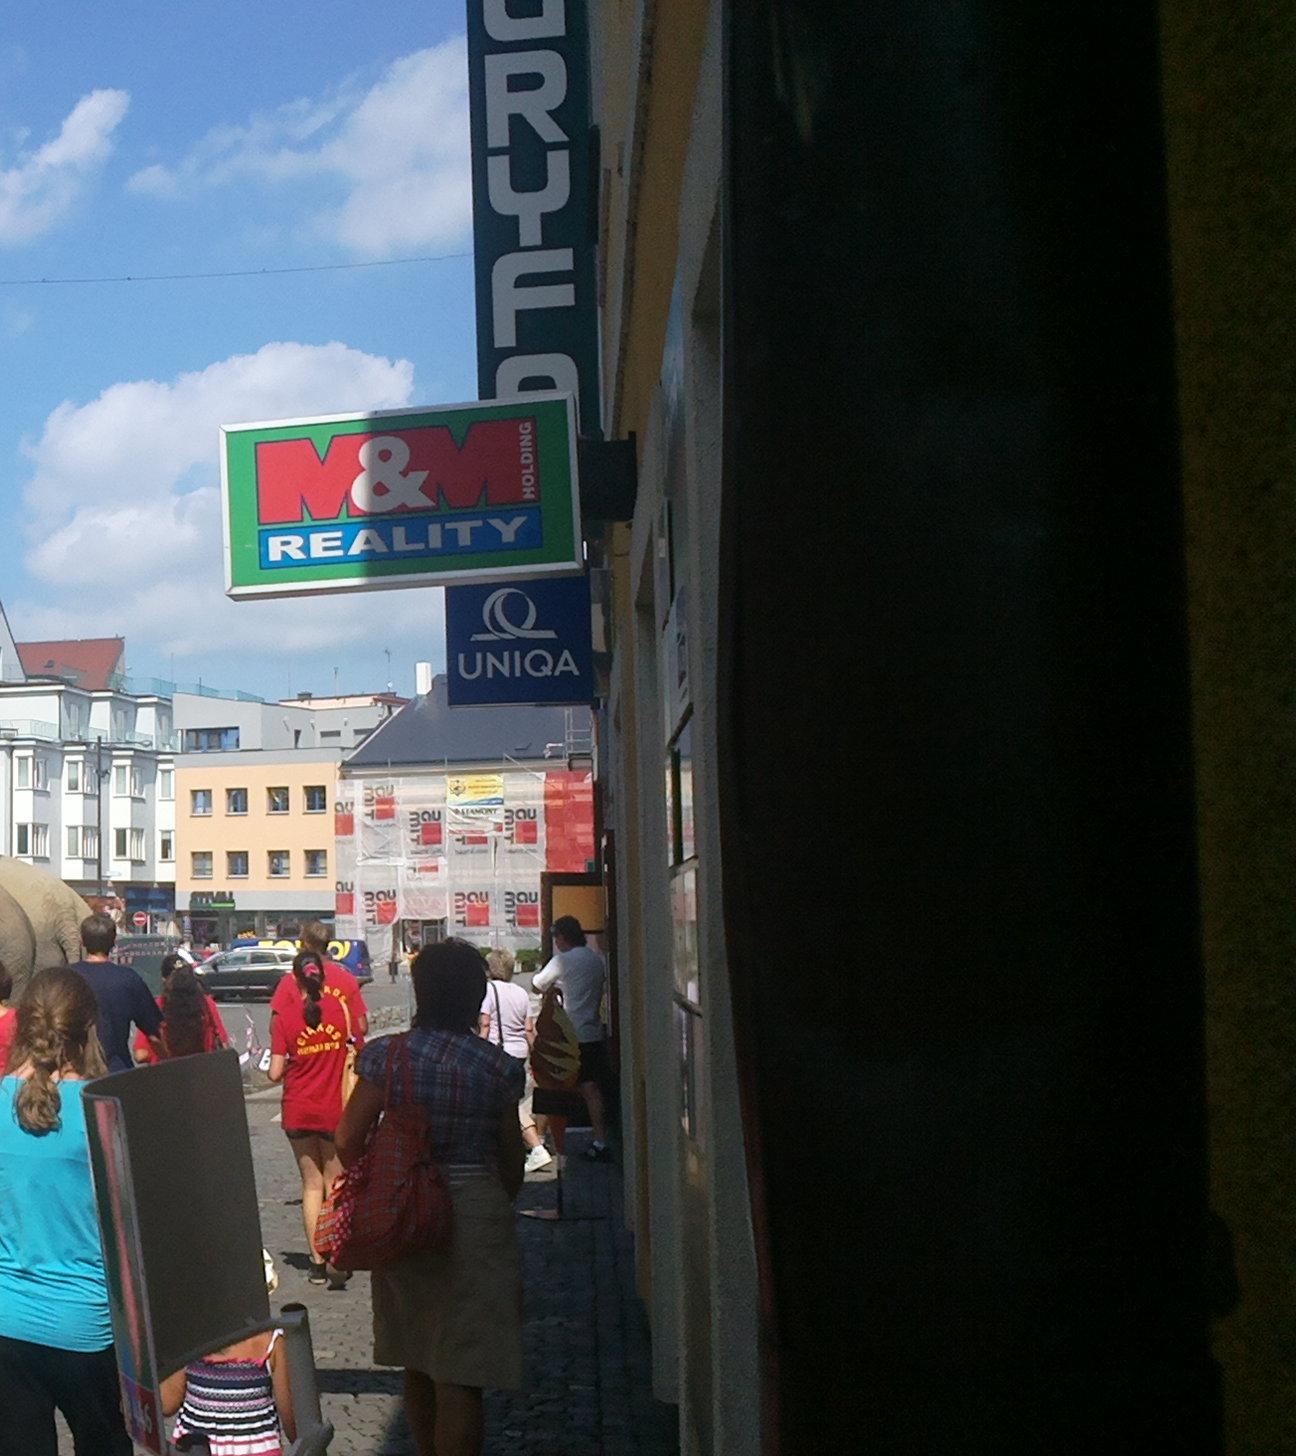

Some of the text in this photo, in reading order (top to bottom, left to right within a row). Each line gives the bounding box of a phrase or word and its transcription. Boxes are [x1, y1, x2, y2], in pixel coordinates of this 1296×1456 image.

[255, 417, 540, 525] M&M
[519, 421, 535, 499] HOLDING
[267, 516, 528, 562] REALITY
[458, 649, 580, 680] UNIQA
